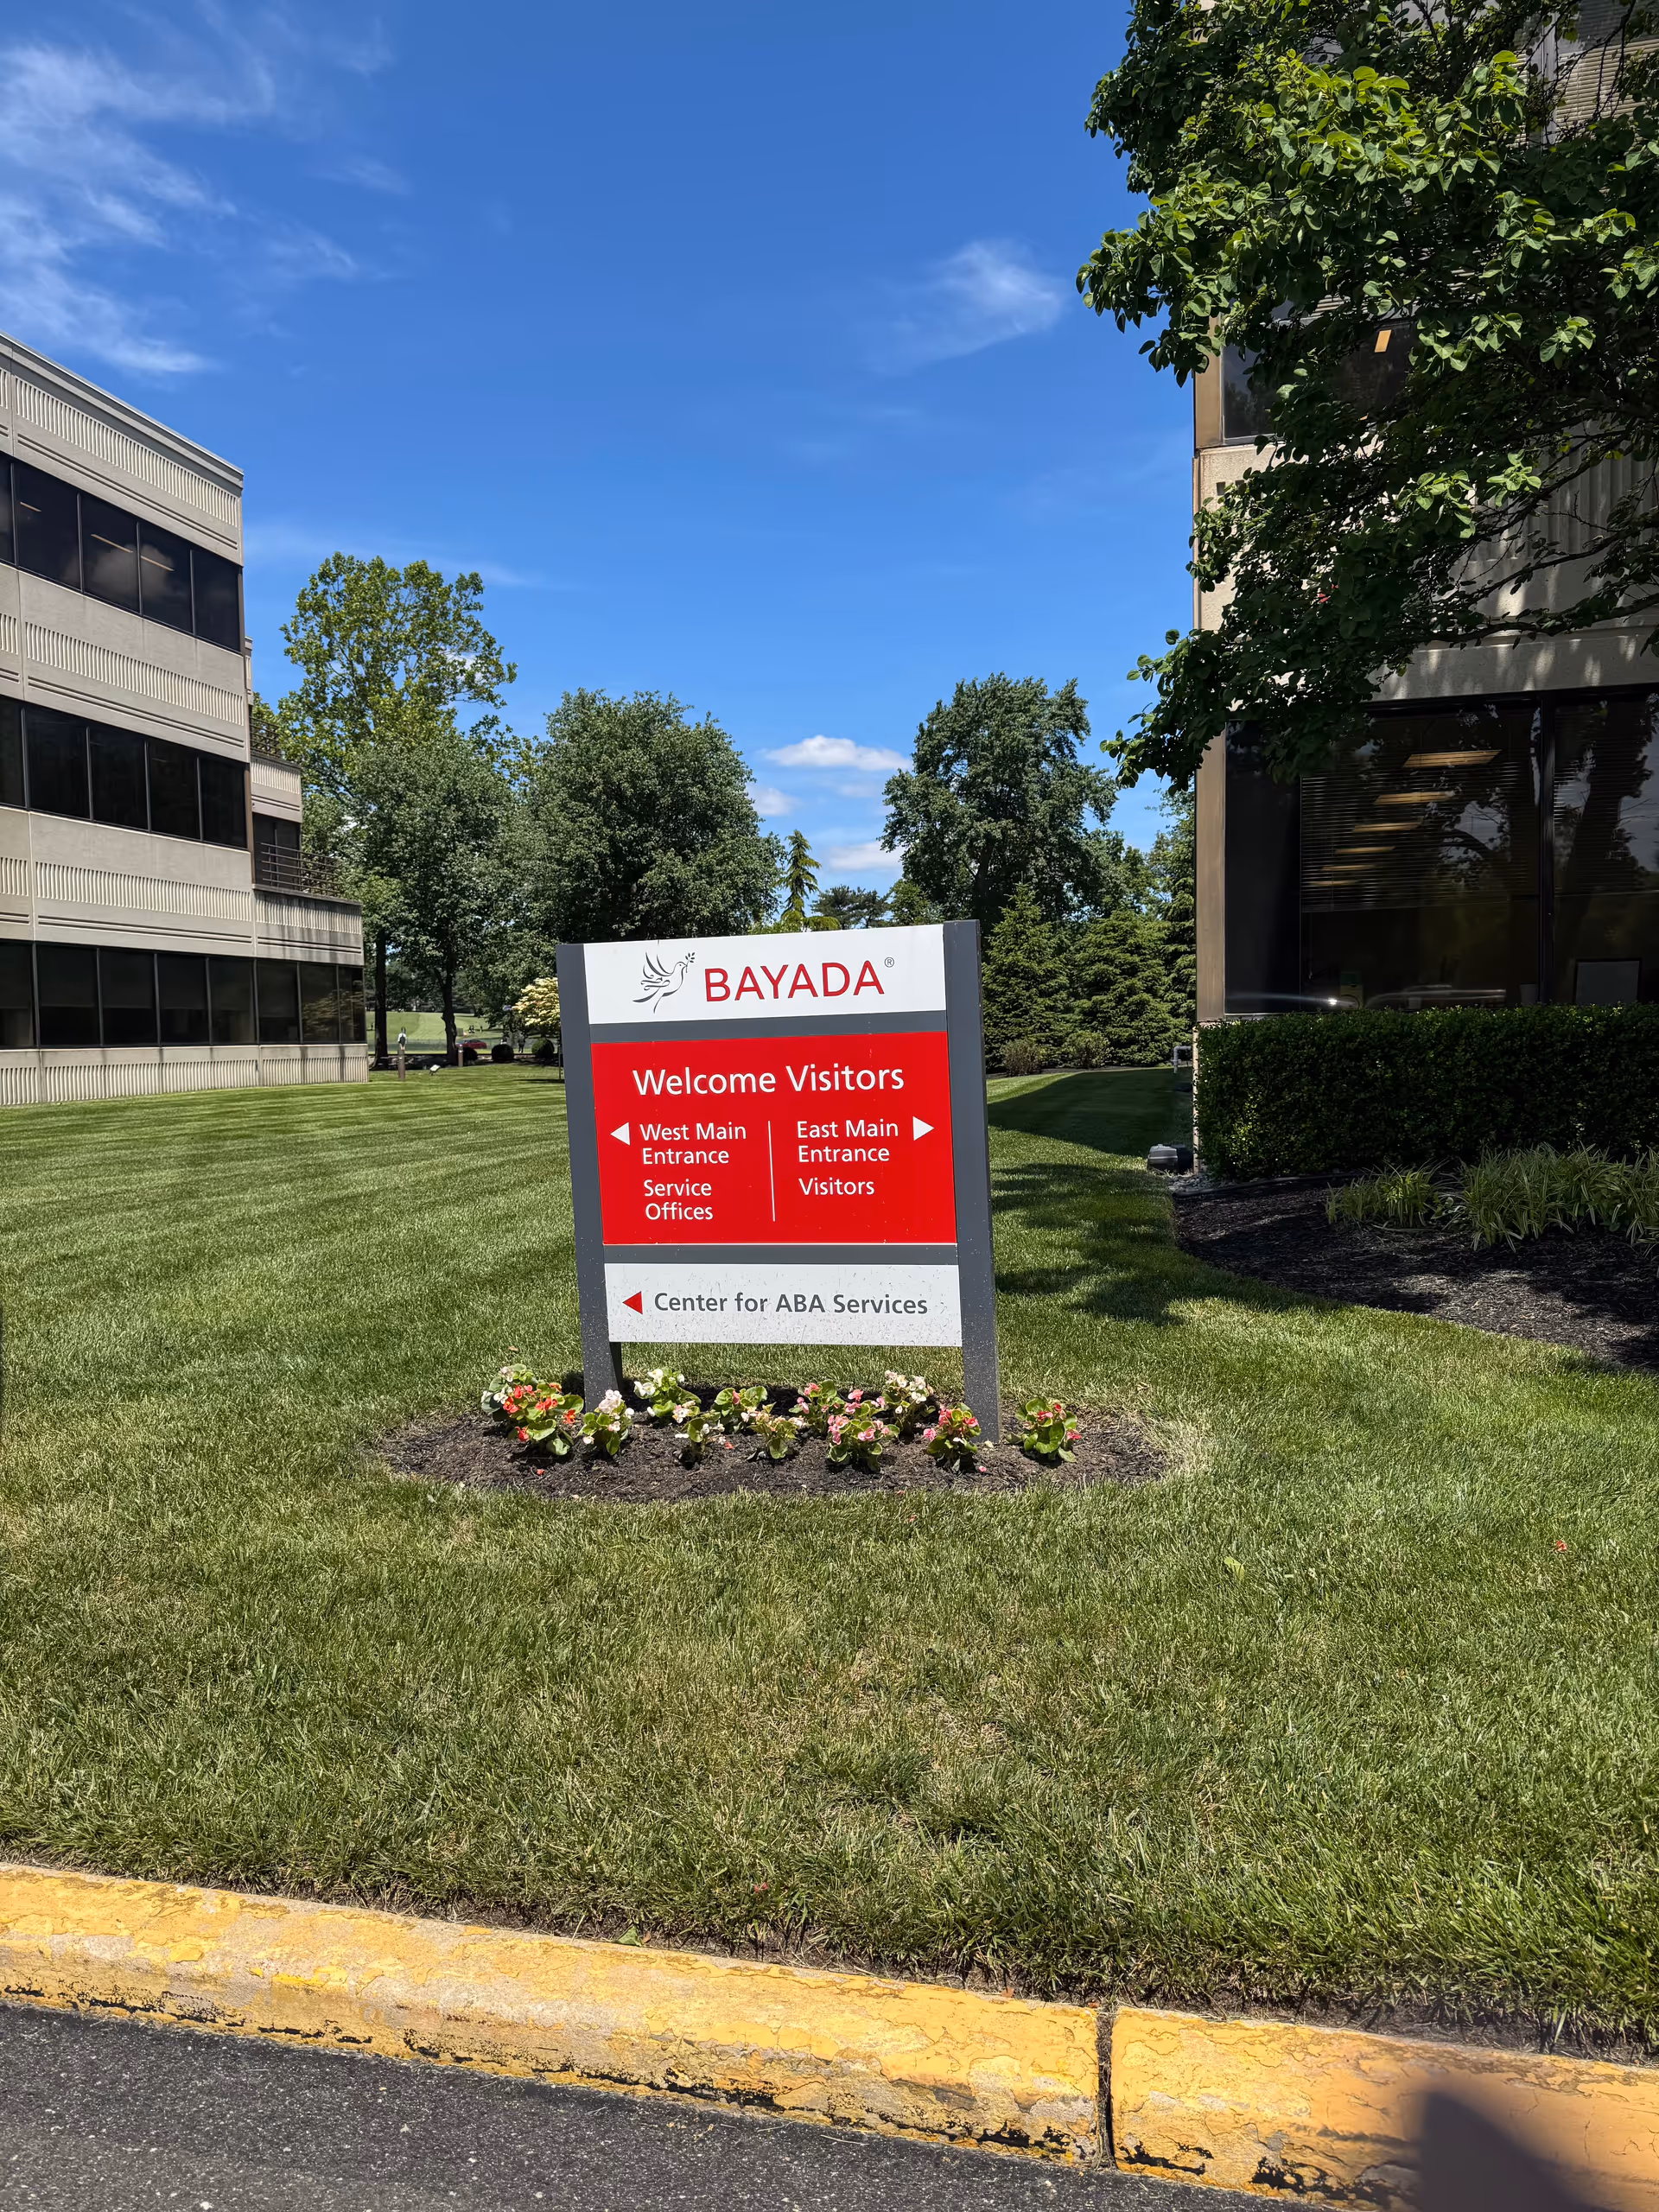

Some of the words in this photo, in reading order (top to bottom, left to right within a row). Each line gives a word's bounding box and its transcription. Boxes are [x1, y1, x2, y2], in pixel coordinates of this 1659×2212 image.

[632, 1066, 777, 1096] Welcome
[785, 1063, 905, 1092] Visitors
[639, 1123, 690, 1141] West
[696, 1121, 747, 1141] Main
[797, 1120, 839, 1139] East
[845, 1118, 899, 1138] Main
[642, 1147, 729, 1165] Entrance
[798, 1145, 890, 1163] Entrance
[643, 1178, 712, 1197] Service
[798, 1177, 875, 1196] Visitors
[645, 1201, 714, 1221] Offices
[654, 1292, 728, 1312] Center
[734, 1292, 768, 1313] for
[775, 1294, 826, 1313] ABA
[833, 1294, 928, 1314] Services
